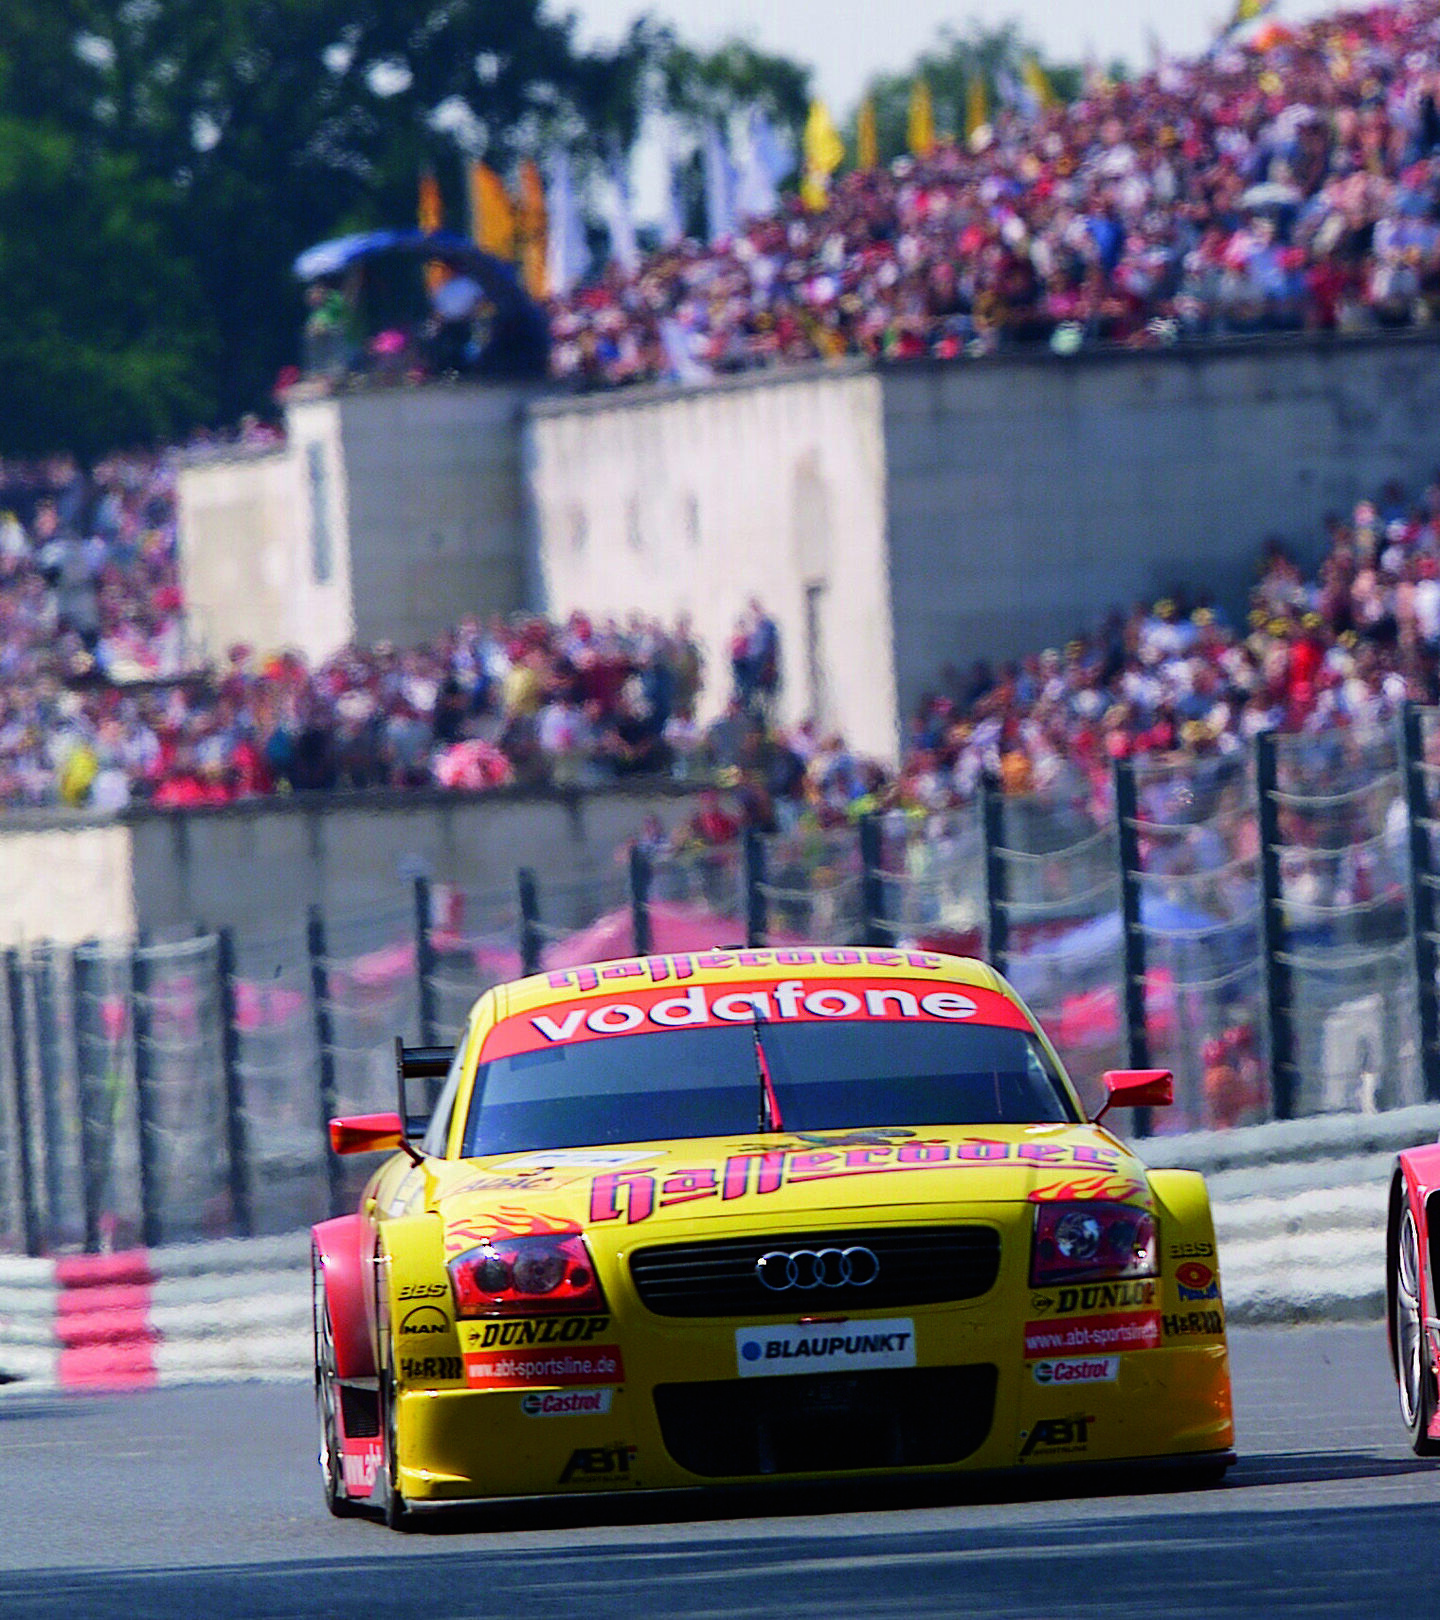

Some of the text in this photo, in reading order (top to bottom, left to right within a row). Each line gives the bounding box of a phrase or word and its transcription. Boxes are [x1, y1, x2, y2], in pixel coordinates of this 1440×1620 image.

[531, 980, 977, 1042] vodafone
[398, 1283, 448, 1301] BBS
[403, 1324, 445, 1334] MAN
[480, 1317, 610, 1347] DUNLOP
[765, 1332, 911, 1359] BLAUPUNKT
[468, 1357, 616, 1379] www.abt-sportsline.de
[1054, 1360, 1110, 1381] Castrol
[542, 1393, 601, 1412] Castrol
[1018, 1414, 1096, 1456] ABT
[558, 1446, 637, 1484] ABT
